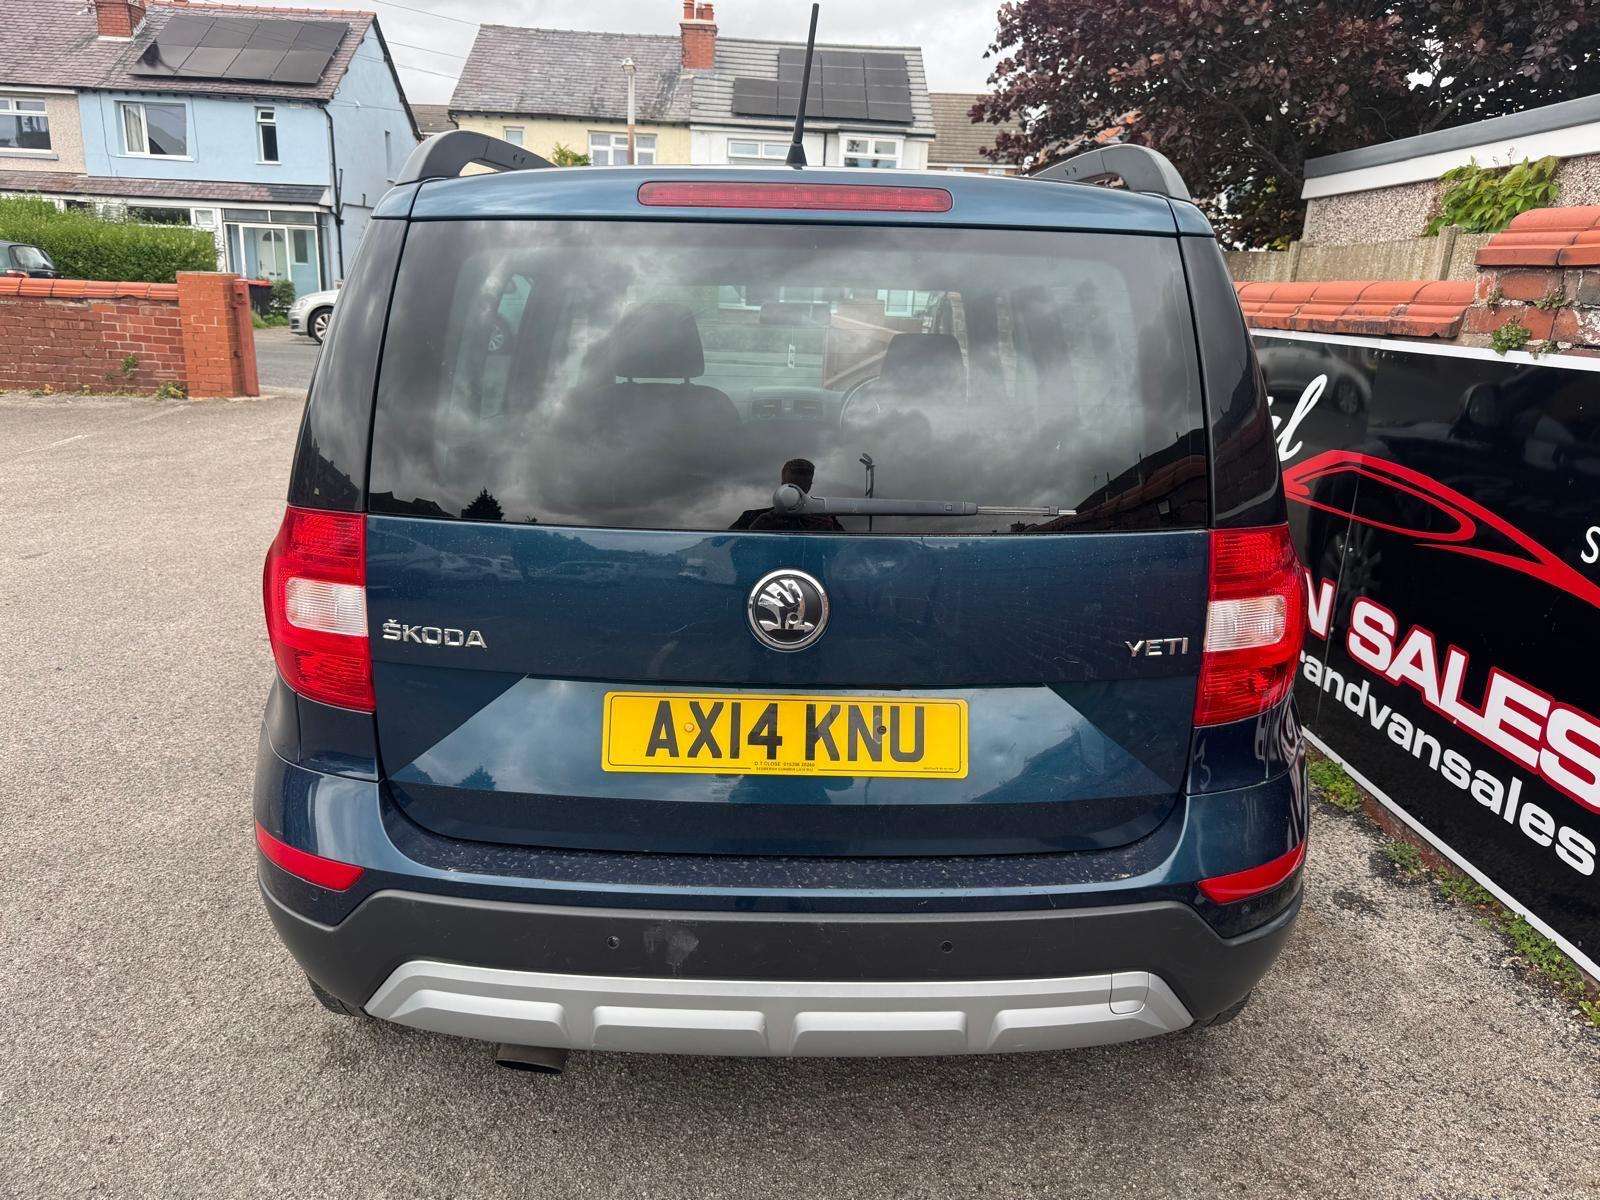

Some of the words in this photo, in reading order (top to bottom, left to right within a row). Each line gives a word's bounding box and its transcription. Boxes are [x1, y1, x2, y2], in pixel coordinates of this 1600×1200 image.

[382, 618, 488, 648] ŠKODA
[1124, 636, 1189, 657] YETI
[645, 700, 783, 760] AX14
[805, 703, 925, 763] KNU
[1347, 597, 1600, 812] SALES
[1300, 650, 1597, 876] andvansales
